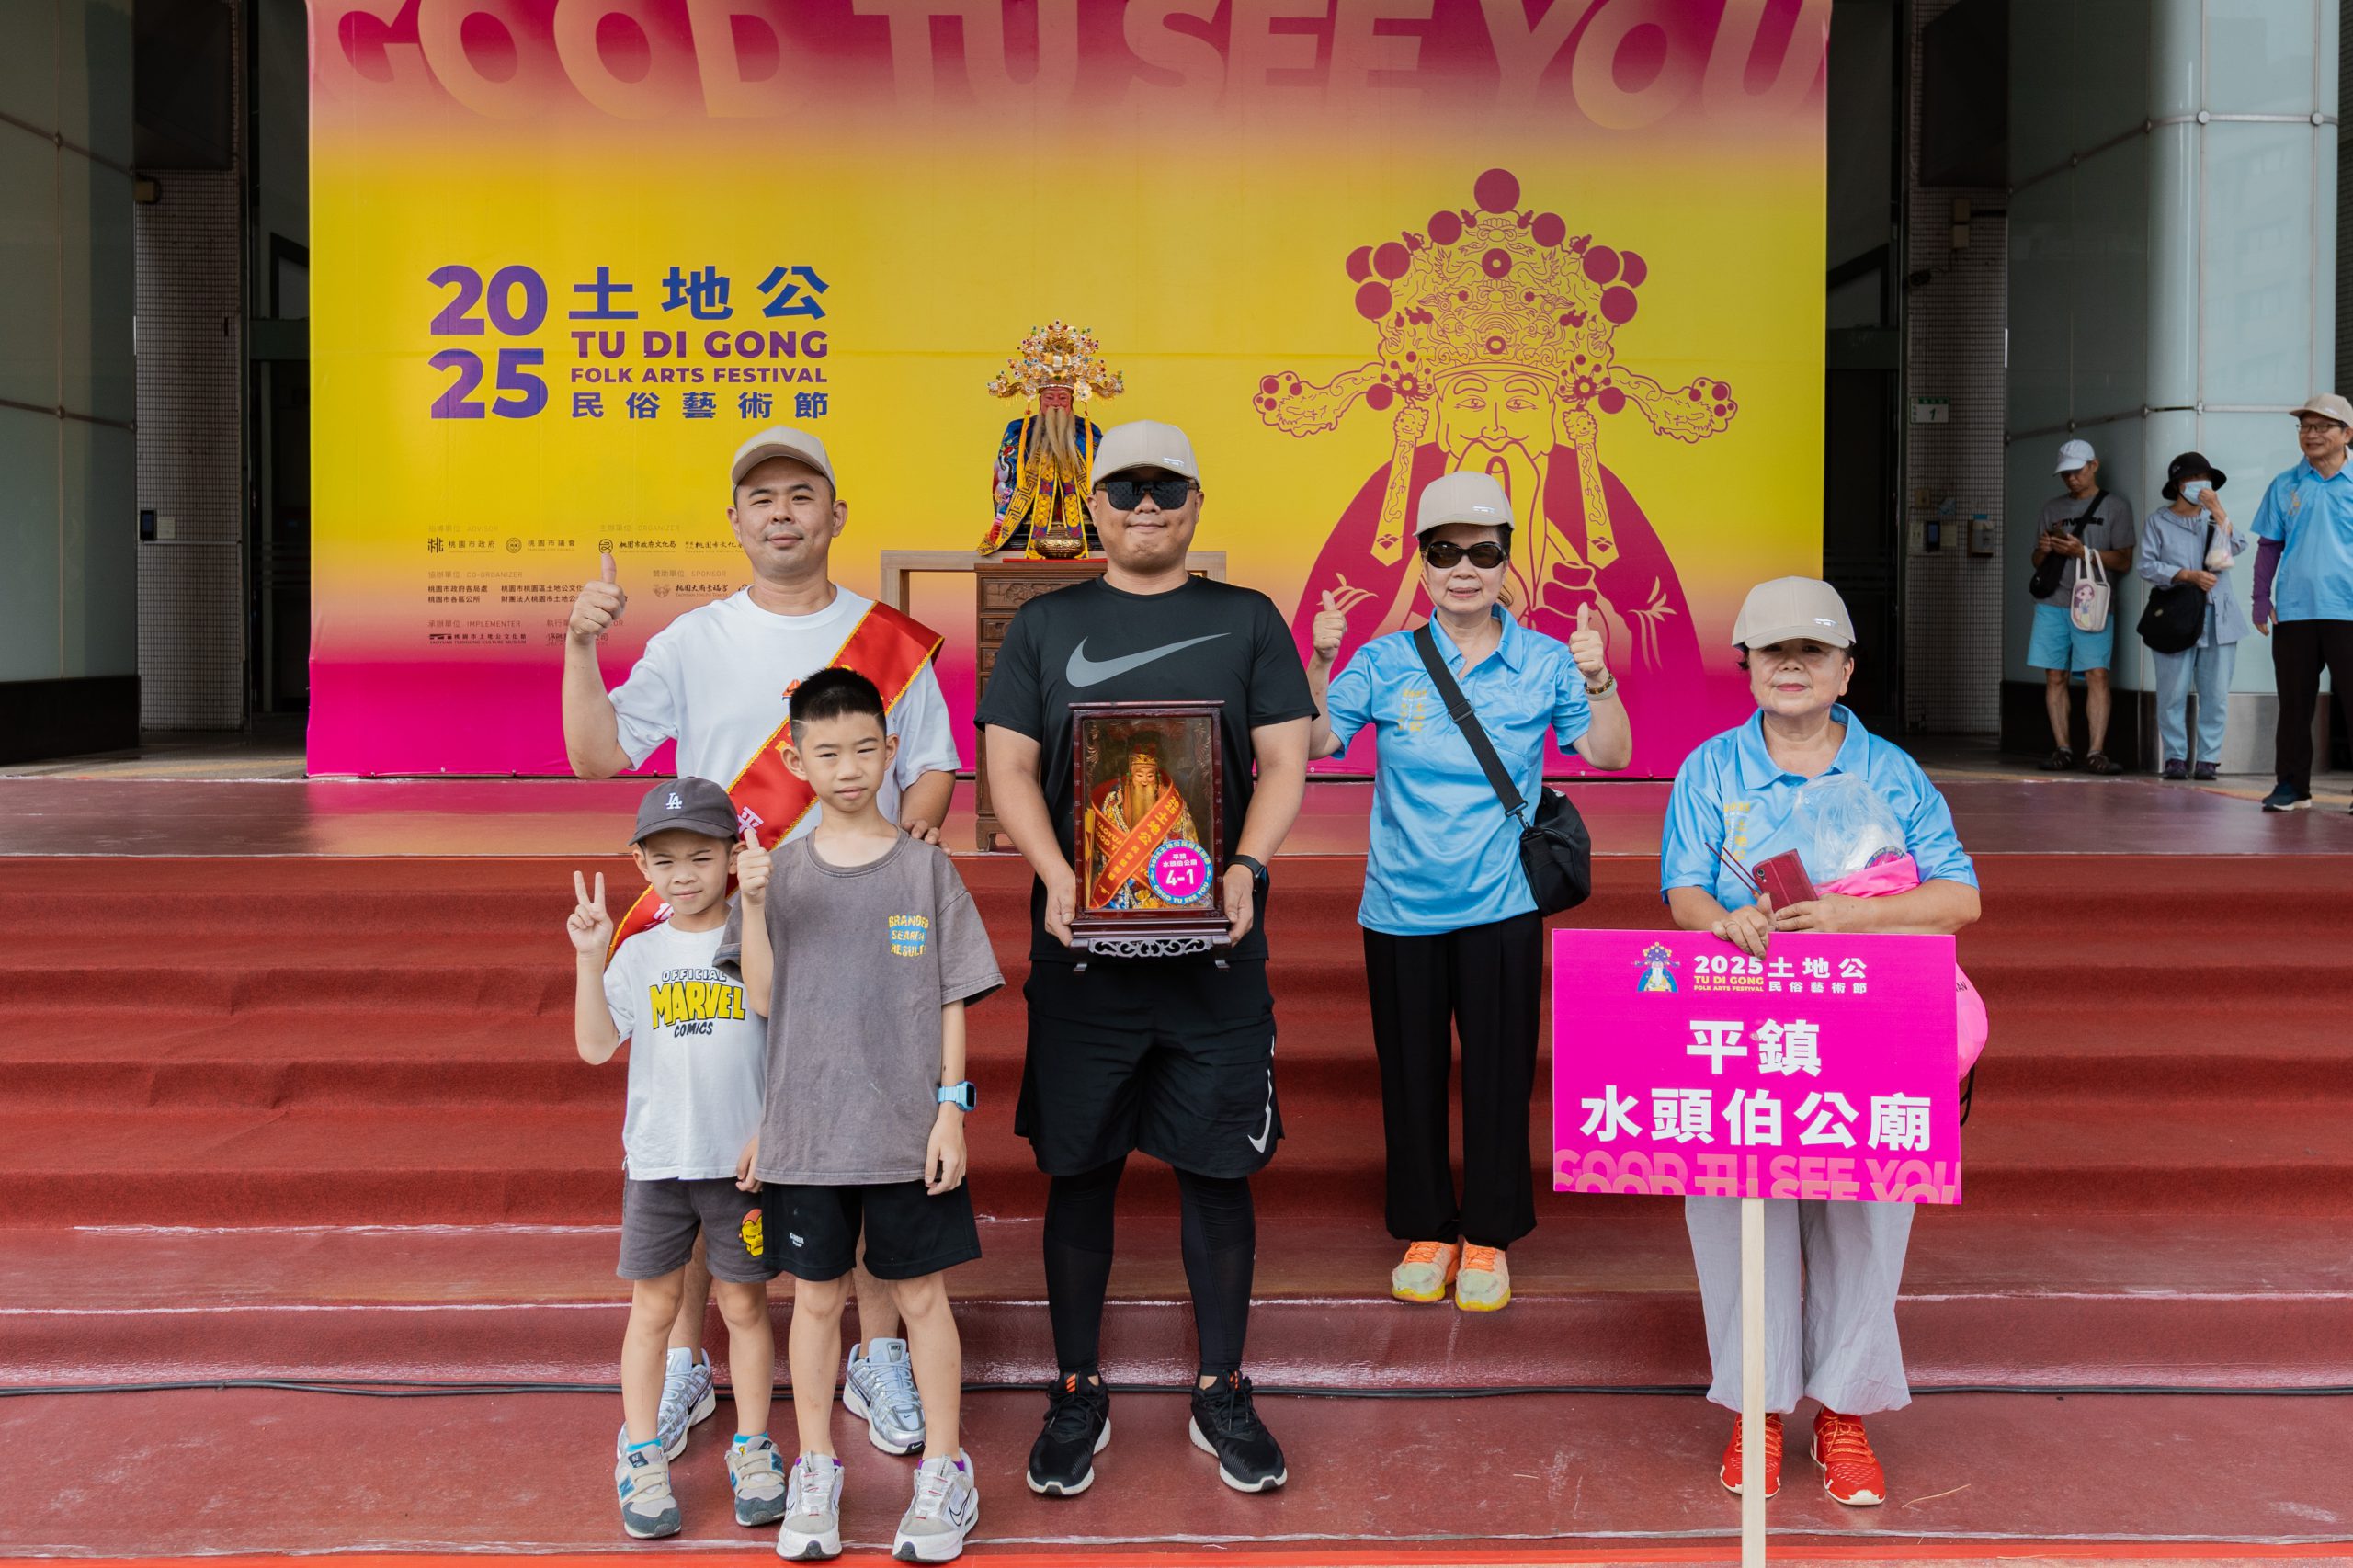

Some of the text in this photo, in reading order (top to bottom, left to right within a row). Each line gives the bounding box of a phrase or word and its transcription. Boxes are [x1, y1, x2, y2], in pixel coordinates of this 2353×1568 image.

[313, 0, 1827, 129] GOOD TU SEE YOU
[426, 265, 548, 336] 20
[568, 266, 830, 320] 土地公
[571, 331, 828, 358] TU DI GONG
[426, 348, 549, 419] 25
[571, 368, 828, 383] FOLK ARTS FESTIVAL
[571, 392, 828, 419] 民俗藝術節
[665, 792, 683, 810] LA
[1165, 869, 1194, 886] 4-1
[662, 968, 727, 982] OFFICIAL
[1694, 955, 1764, 974] 2025
[1768, 957, 1868, 979] 土地公
[1694, 975, 1764, 985] TU DI GONG
[1768, 981, 1868, 994] 民俗藝術節
[649, 981, 746, 1030] MARVEL
[674, 1021, 714, 1038] COMICS
[1686, 1018, 1822, 1077] 平鎮
[1580, 1085, 1931, 1152] 水頭伯公廟
